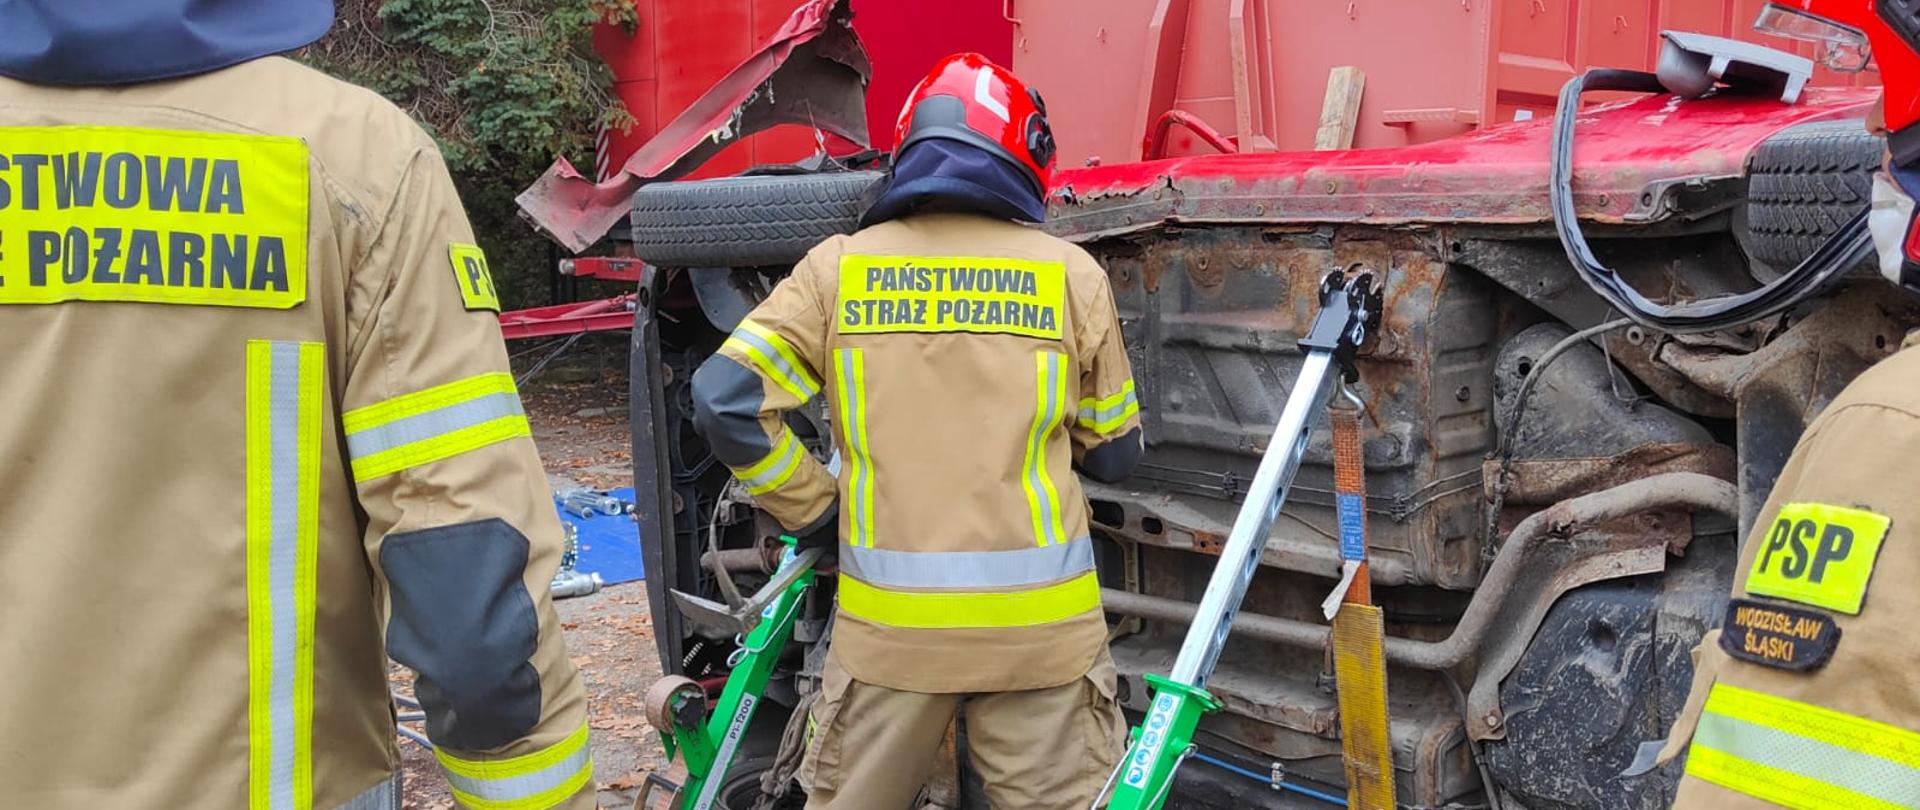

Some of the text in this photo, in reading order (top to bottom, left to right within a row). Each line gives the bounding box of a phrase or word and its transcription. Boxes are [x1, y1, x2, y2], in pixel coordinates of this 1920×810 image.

[28, 225, 289, 293] POŻARNA
[866, 262, 1037, 296] PAŃSTWOWA
[844, 299, 1056, 331] STRAŻ POŻARNA
[1758, 518, 1854, 585] PSP
[1736, 606, 1822, 641] WODZISŁAW
[1744, 629, 1794, 662] ŚLĄSKI
